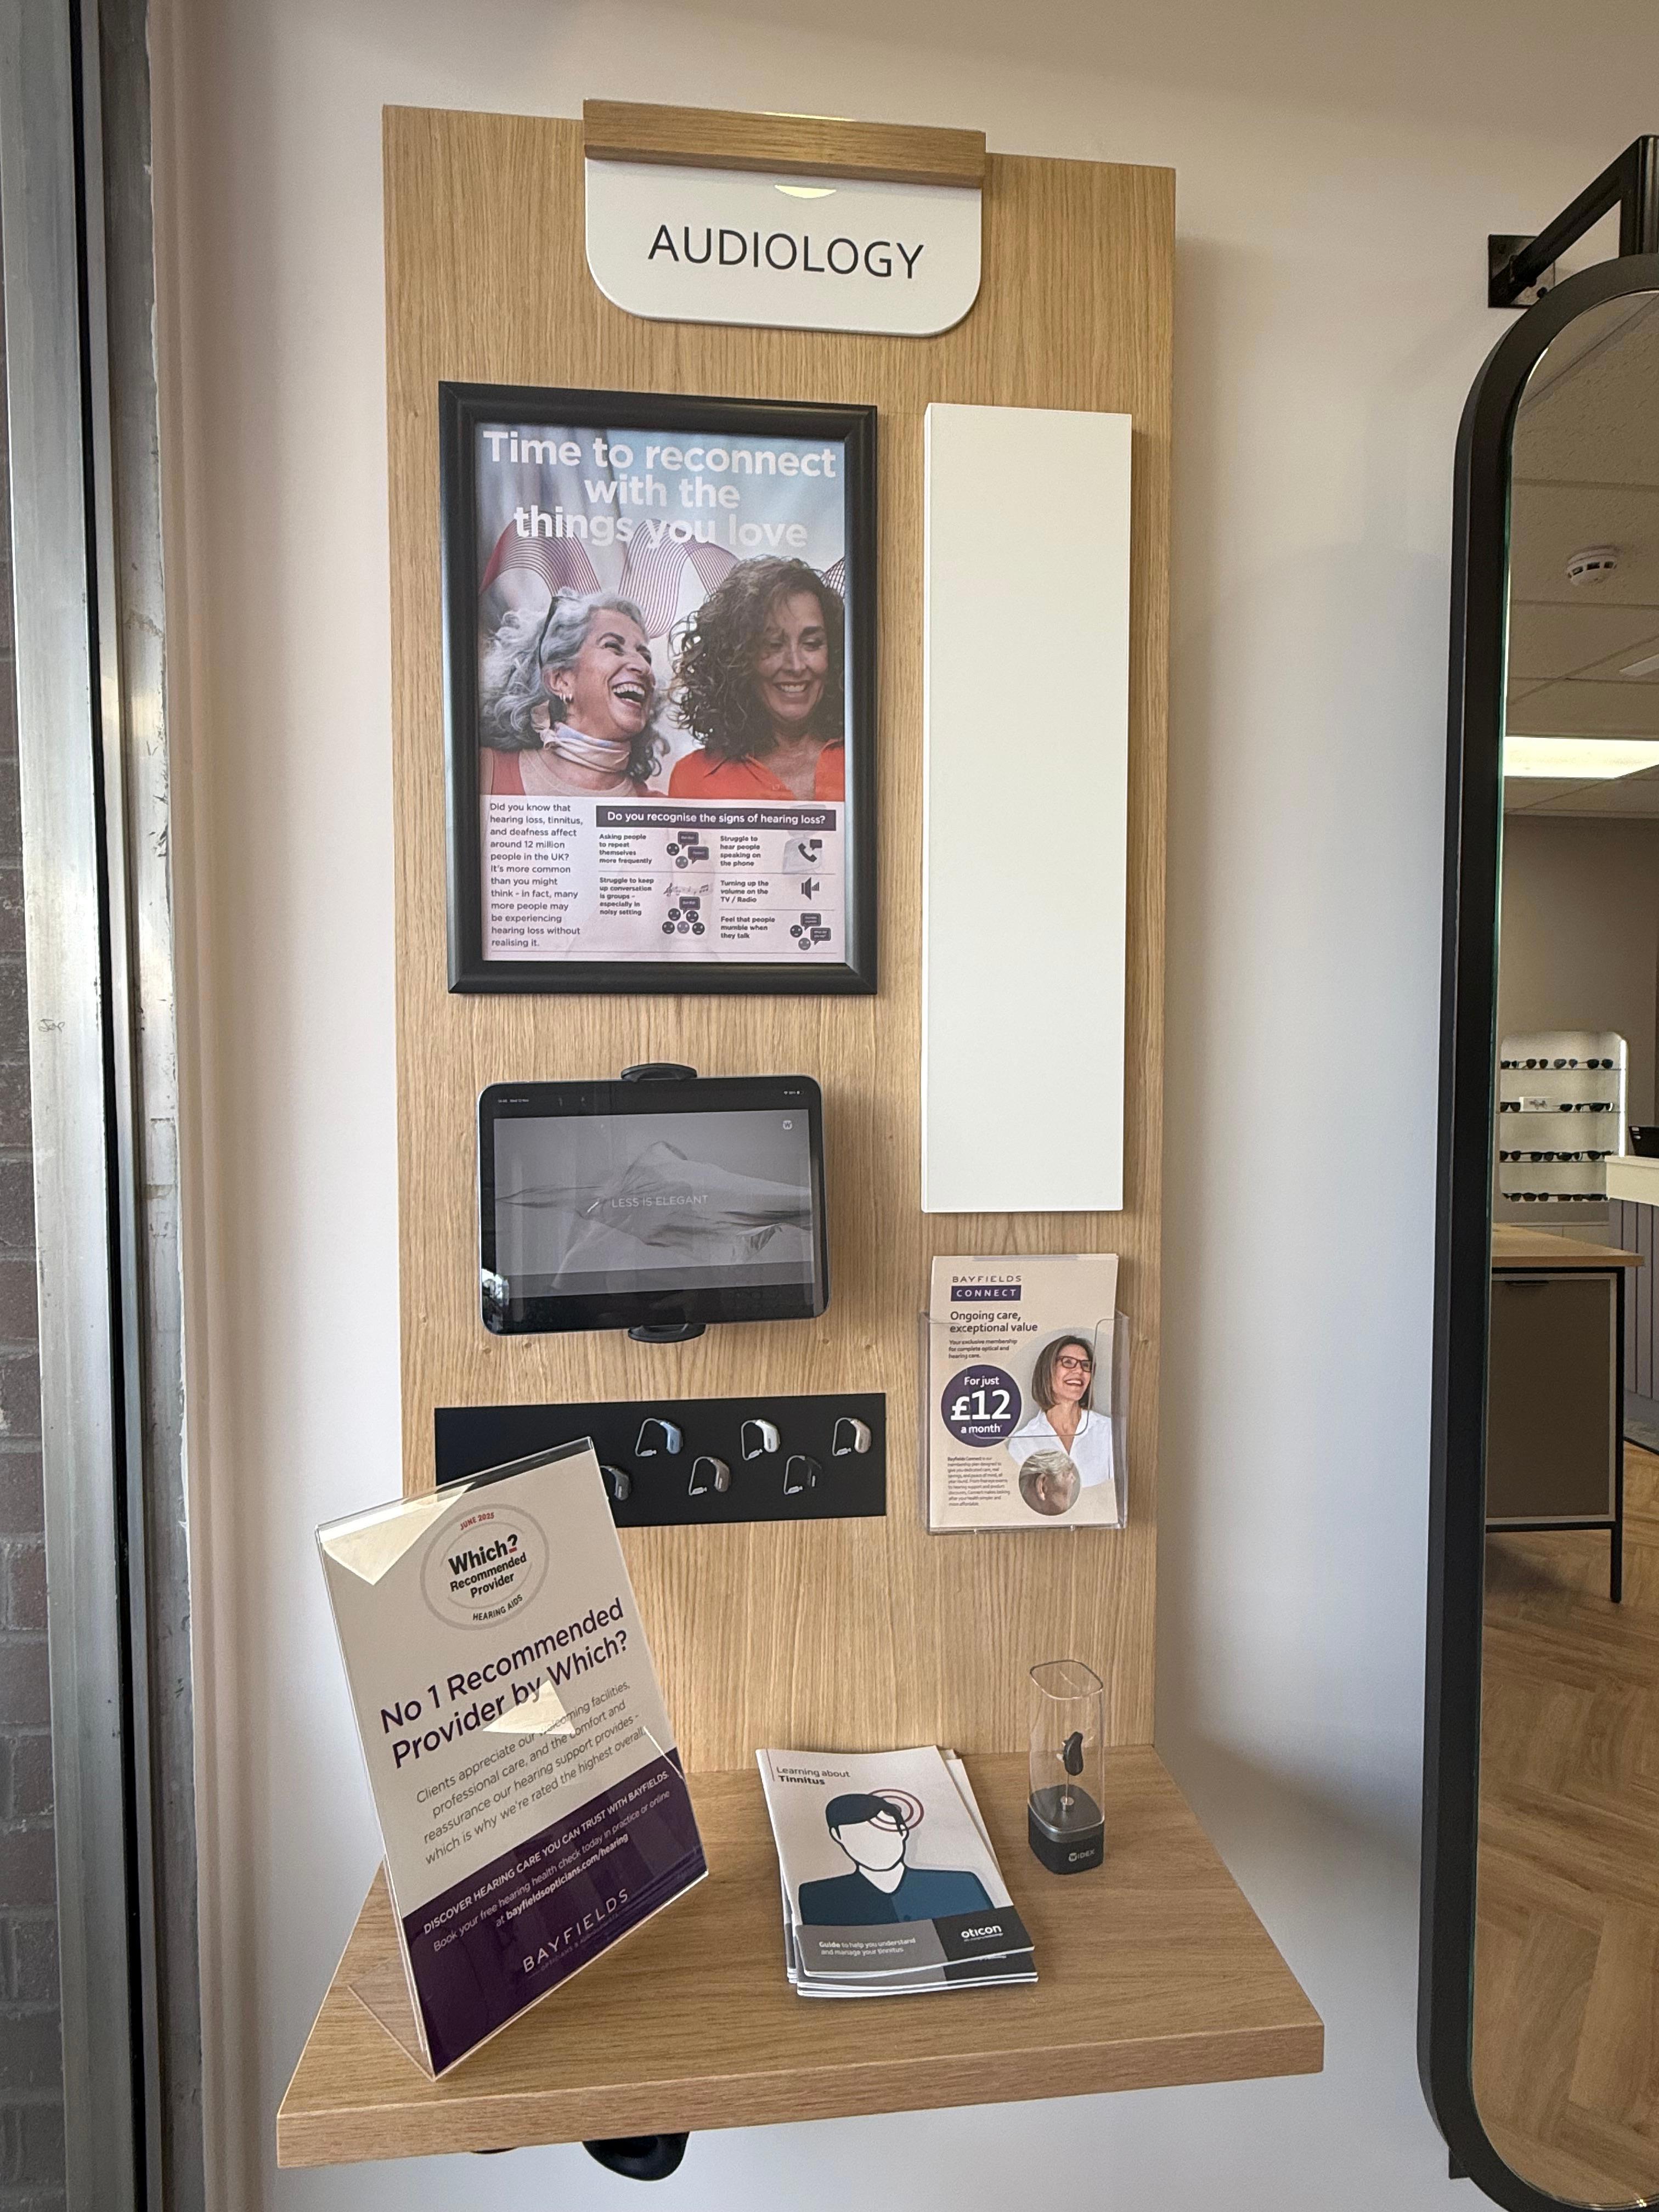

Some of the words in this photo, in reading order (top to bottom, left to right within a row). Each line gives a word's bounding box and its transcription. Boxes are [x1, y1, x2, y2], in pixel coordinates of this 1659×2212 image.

[648, 224, 924, 279] AUDIOLOGY
[483, 431, 581, 466] Time
[593, 438, 633, 469] to
[646, 446, 836, 478] reconnect
[585, 475, 668, 507] with
[679, 477, 740, 508] the
[514, 506, 633, 545] things
[646, 520, 715, 549] you
[729, 515, 808, 547] love
[526, 803, 550, 811] know
[552, 803, 571, 811] that
[490, 815, 523, 825] hearing
[526, 815, 545, 825] loss,
[548, 816, 583, 825] tinnitus,
[607, 811, 622, 820] Do
[625, 813, 644, 822] you
[647, 812, 696, 822] recognise
[699, 813, 716, 822] the
[719, 813, 744, 823] signs
[747, 813, 758, 822] of
[760, 814, 798, 825] hearing
[801, 814, 825, 823] loss?
[509, 827, 549, 836] deafness
[551, 828, 577, 837] affect
[490, 852, 521, 861] people
[551, 853, 569, 861] UK?
[532, 877, 557, 887] might
[532, 889, 551, 898] fact,
[517, 901, 547, 911] people
[505, 913, 562, 923] experiencing
[491, 926, 524, 935] hearing
[527, 926, 544, 934] loss
[546, 926, 580, 934] without
[492, 938, 528, 947] realising
[531, 938, 539, 946] it.
[612, 1197, 639, 1208] LESS
[642, 1196, 652, 1207] IS
[656, 1194, 708, 1206] ELEGANT
[956, 1289, 1015, 1297] CONNECT
[950, 1310, 994, 1323] Ongoing
[996, 1312, 1021, 1322] care,
[950, 1322, 1008, 1335] exceptional
[1011, 1322, 1037, 1331] value
[964, 1376, 980, 1385] For
[980, 1375, 999, 1387] just
[951, 1390, 1011, 1421] £12
[460, 1516, 477, 1531] JUNE
[478, 1512, 495, 1523] 2025
[448, 1534, 517, 1575] Which?
[449, 1551, 527, 1592] Recommended
[470, 1573, 514, 1598] Provider
[472, 1606, 506, 1621] HEARING
[507, 1594, 523, 1611] AIDS
[380, 1700, 421, 1734] No
[427, 1684, 440, 1708] 1
[447, 1596, 623, 1701] Recommended
[392, 1695, 504, 1769] Provider
[511, 1677, 540, 1706] by
[546, 1629, 626, 1685] Which?
[432, 1769, 499, 1819] professional
[529, 1742, 549, 1762] and
[550, 1734, 567, 1749] the
[567, 1711, 607, 1739] comfort
[608, 1699, 625, 1725] and
[416, 1775, 456, 1803] Clients
[458, 1743, 515, 1781] appreciate
[518, 1733, 534, 1747] our
[776, 1767, 820, 1778] Learning
[424, 1798, 491, 1844] reassurance
[493, 1785, 511, 1803] our
[513, 1762, 553, 1791] hearing
[555, 1738, 593, 1767] support
[595, 1716, 633, 1746] provides
[779, 1775, 825, 1785] Tinnitus
[425, 1836, 460, 1864] which
[461, 1831, 472, 1843] is
[473, 1815, 496, 1835] why
[500, 1797, 529, 1819] we're
[531, 1777, 558, 1802] rated
[560, 1769, 577, 1787] the
[577, 1746, 613, 1773] highest
[1068, 1849, 1095, 1861] WIDEX
[424, 1896, 472, 1934] DISCOVER
[473, 1868, 515, 1901] HEARING
[516, 1851, 541, 1872] CARE
[541, 1838, 560, 1856] YOU
[562, 1826, 580, 1844] CAN
[580, 1809, 605, 1831] TRUST
[607, 1796, 627, 1814] WITH
[433, 1930, 458, 1951] Book
[459, 1915, 478, 1937] your
[479, 1904, 497, 1920] free
[498, 1882, 531, 1908] hearing
[531, 1865, 557, 1886] health
[557, 1848, 581, 1869] check
[582, 1834, 602, 1853] today
[603, 1829, 611, 1838] in
[612, 1810, 639, 1834] practice
[640, 1804, 648, 1813] or
[649, 1791, 669, 1808] online
[496, 1915, 504, 1927] at
[505, 1833, 628, 1920] bayfieldsopticians.com/hearing
[523, 1888, 628, 1973] BAYFIELDS
[961, 1925, 1002, 1938] oticon
[878, 1937, 916, 1947] understand
